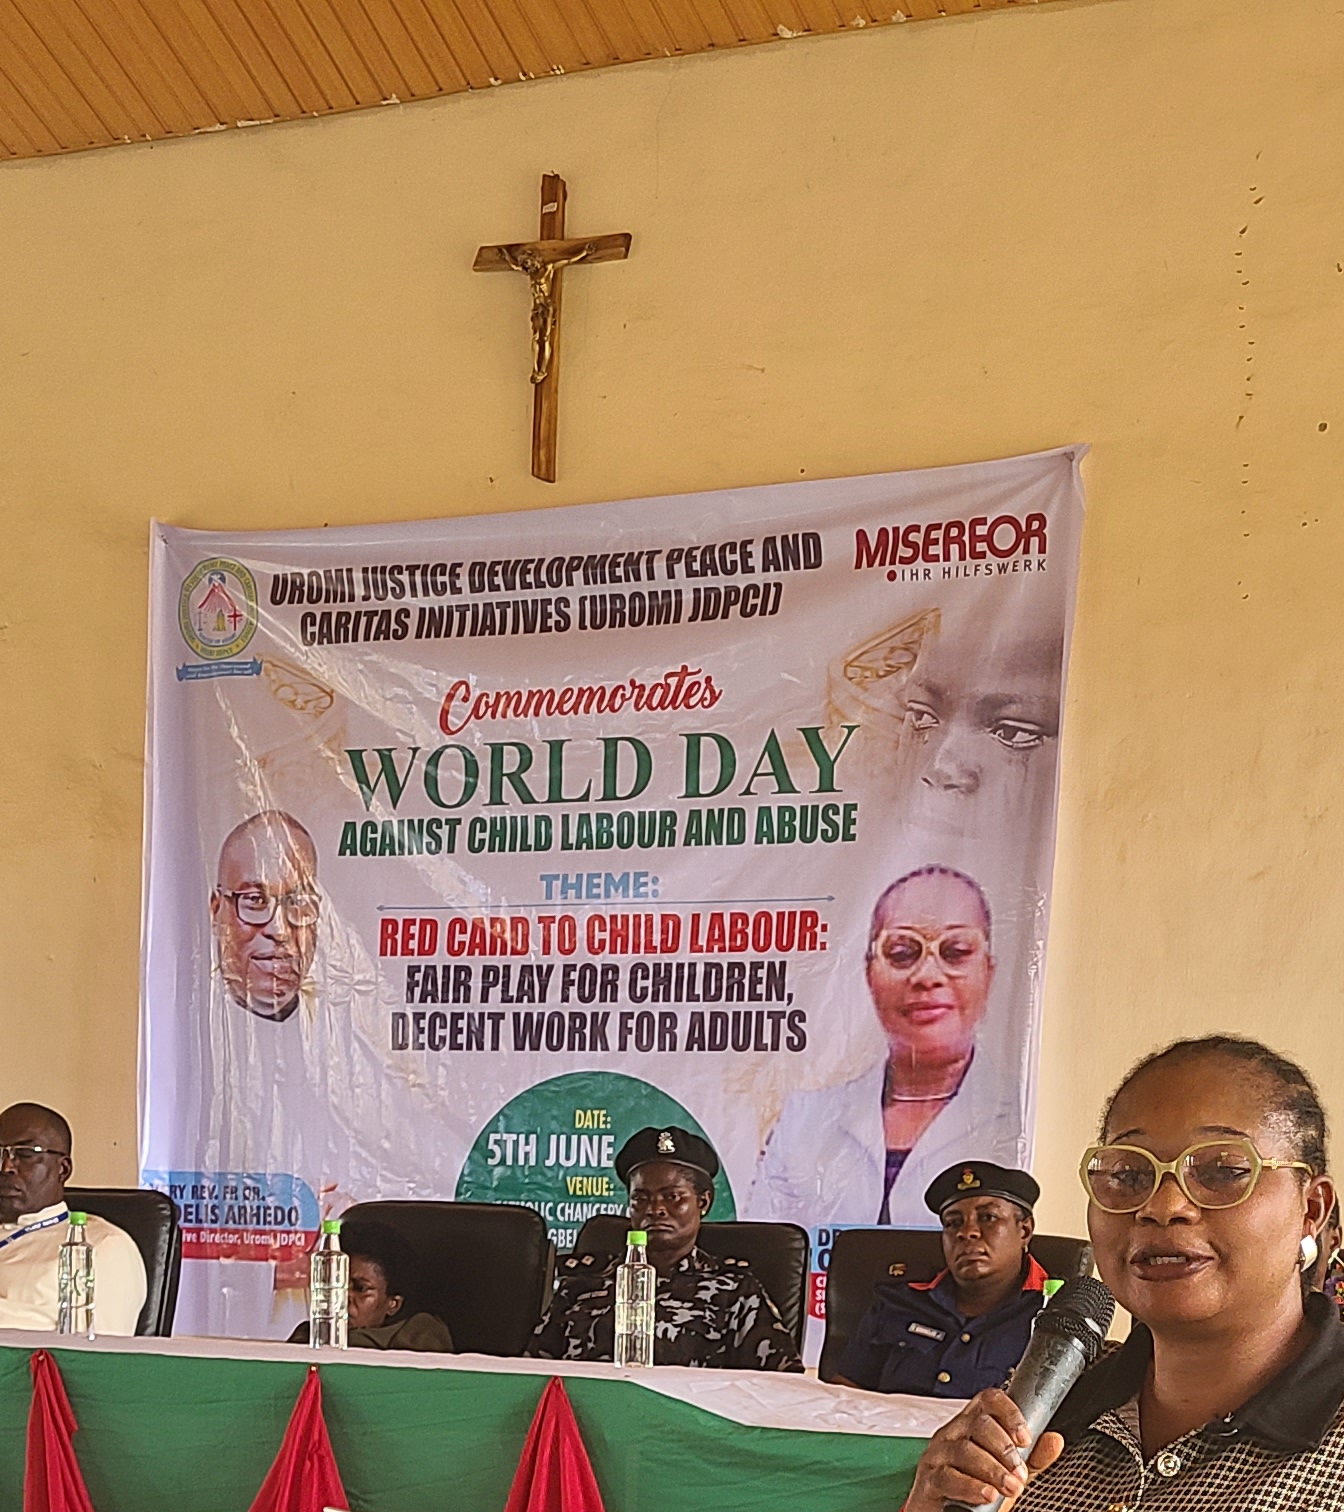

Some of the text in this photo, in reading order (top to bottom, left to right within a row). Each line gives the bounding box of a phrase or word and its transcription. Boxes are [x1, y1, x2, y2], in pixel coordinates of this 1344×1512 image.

[854, 512, 1047, 570] MISEREOR
[269, 532, 823, 605] UROMI JUSTICE DEVELOPMENT PEACE AND
[901, 558, 1047, 582] IHR HILFSWERK
[300, 608, 410, 647] CARITAS
[414, 597, 571, 639] INITIATIVES
[438, 664, 724, 736] Commemorates
[344, 724, 861, 812] WORLD DAY
[338, 803, 858, 857] AGAINST CHILD LABOUR AND ABUSE
[539, 871, 660, 901] THEME:
[378, 910, 829, 957] RED CARD TO CHILD LABOUR:
[405, 961, 794, 1007] FAIR PLAY FOR CHILDREN,
[390, 1009, 808, 1052] DECENT WORK FOR ADULTS
[575, 1109, 612, 1129] DATE:
[487, 1133, 615, 1168] 5TH JUNE
[191, 1183, 219, 1200] REV.
[566, 1176, 615, 1197] VENUE:
[224, 1205, 299, 1227] ARHEDO
[199, 1230, 241, 1246] Director,
[244, 1231, 275, 1247] Uromi
[277, 1232, 305, 1248] JDPCI
